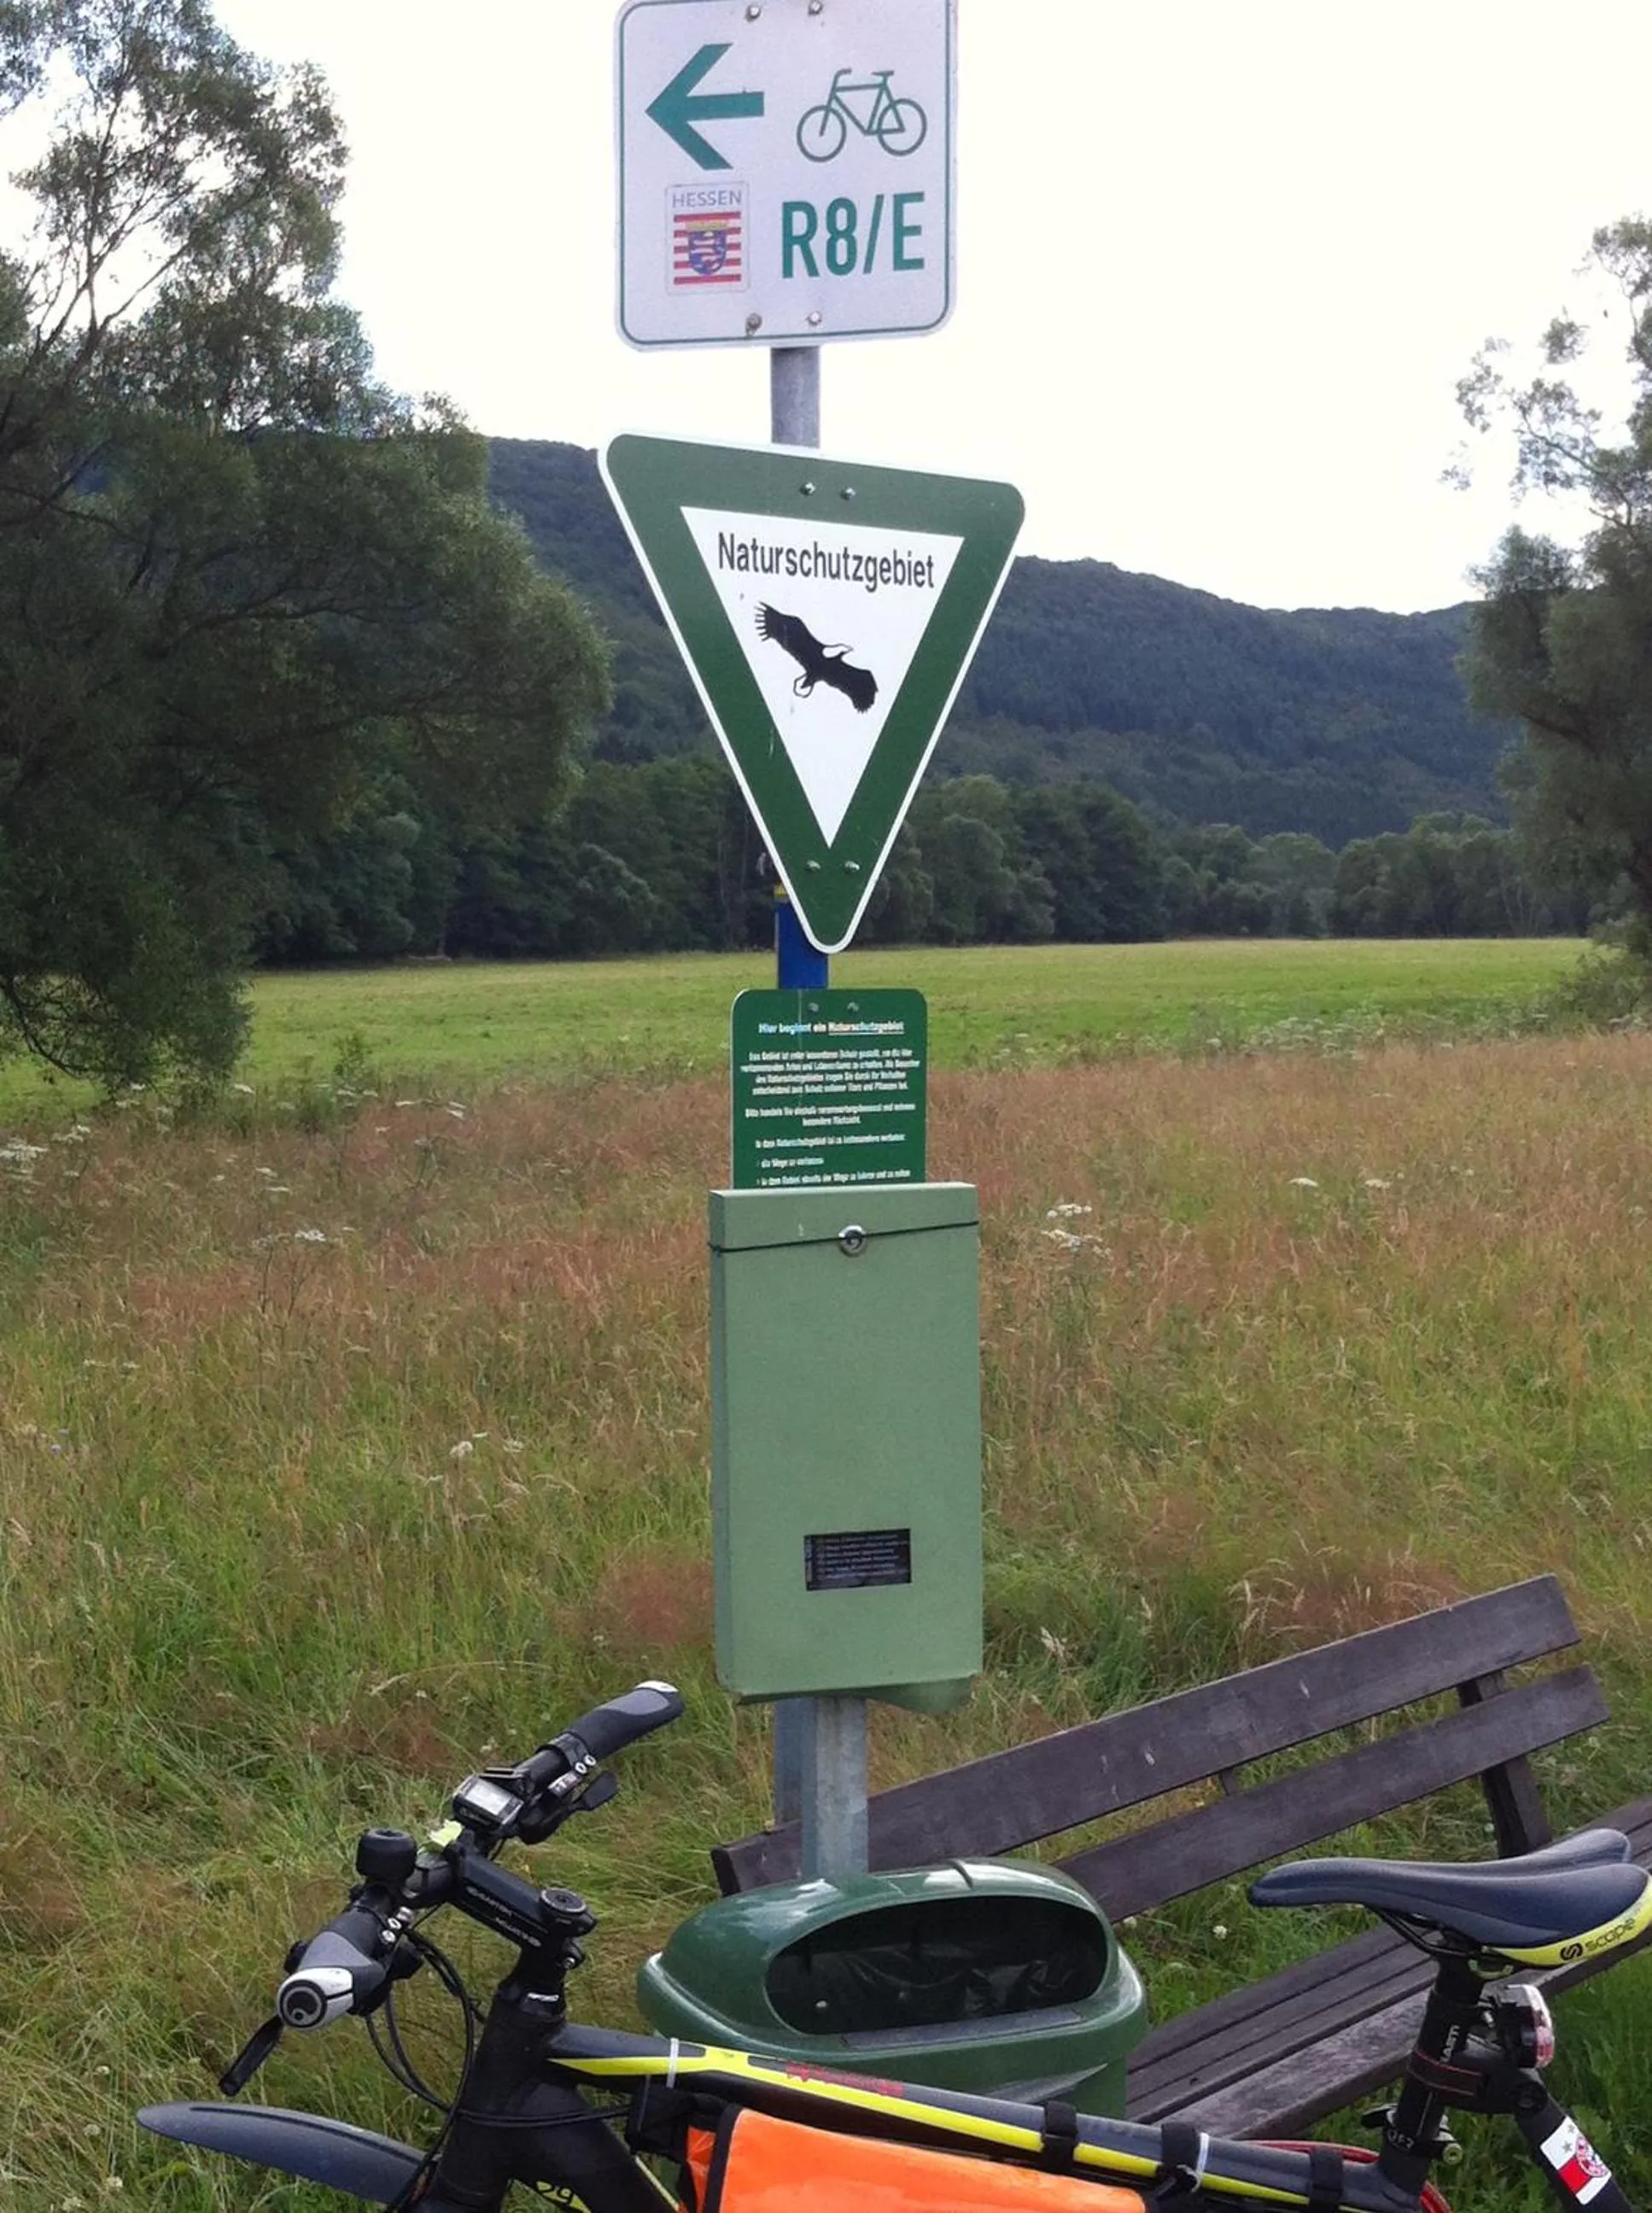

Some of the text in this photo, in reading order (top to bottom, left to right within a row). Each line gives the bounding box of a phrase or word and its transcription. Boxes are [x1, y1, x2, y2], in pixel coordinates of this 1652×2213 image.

[672, 190, 742, 208] HESSEN
[781, 191, 925, 279] R8/E
[718, 531, 935, 593] Naturschutzgebiet
